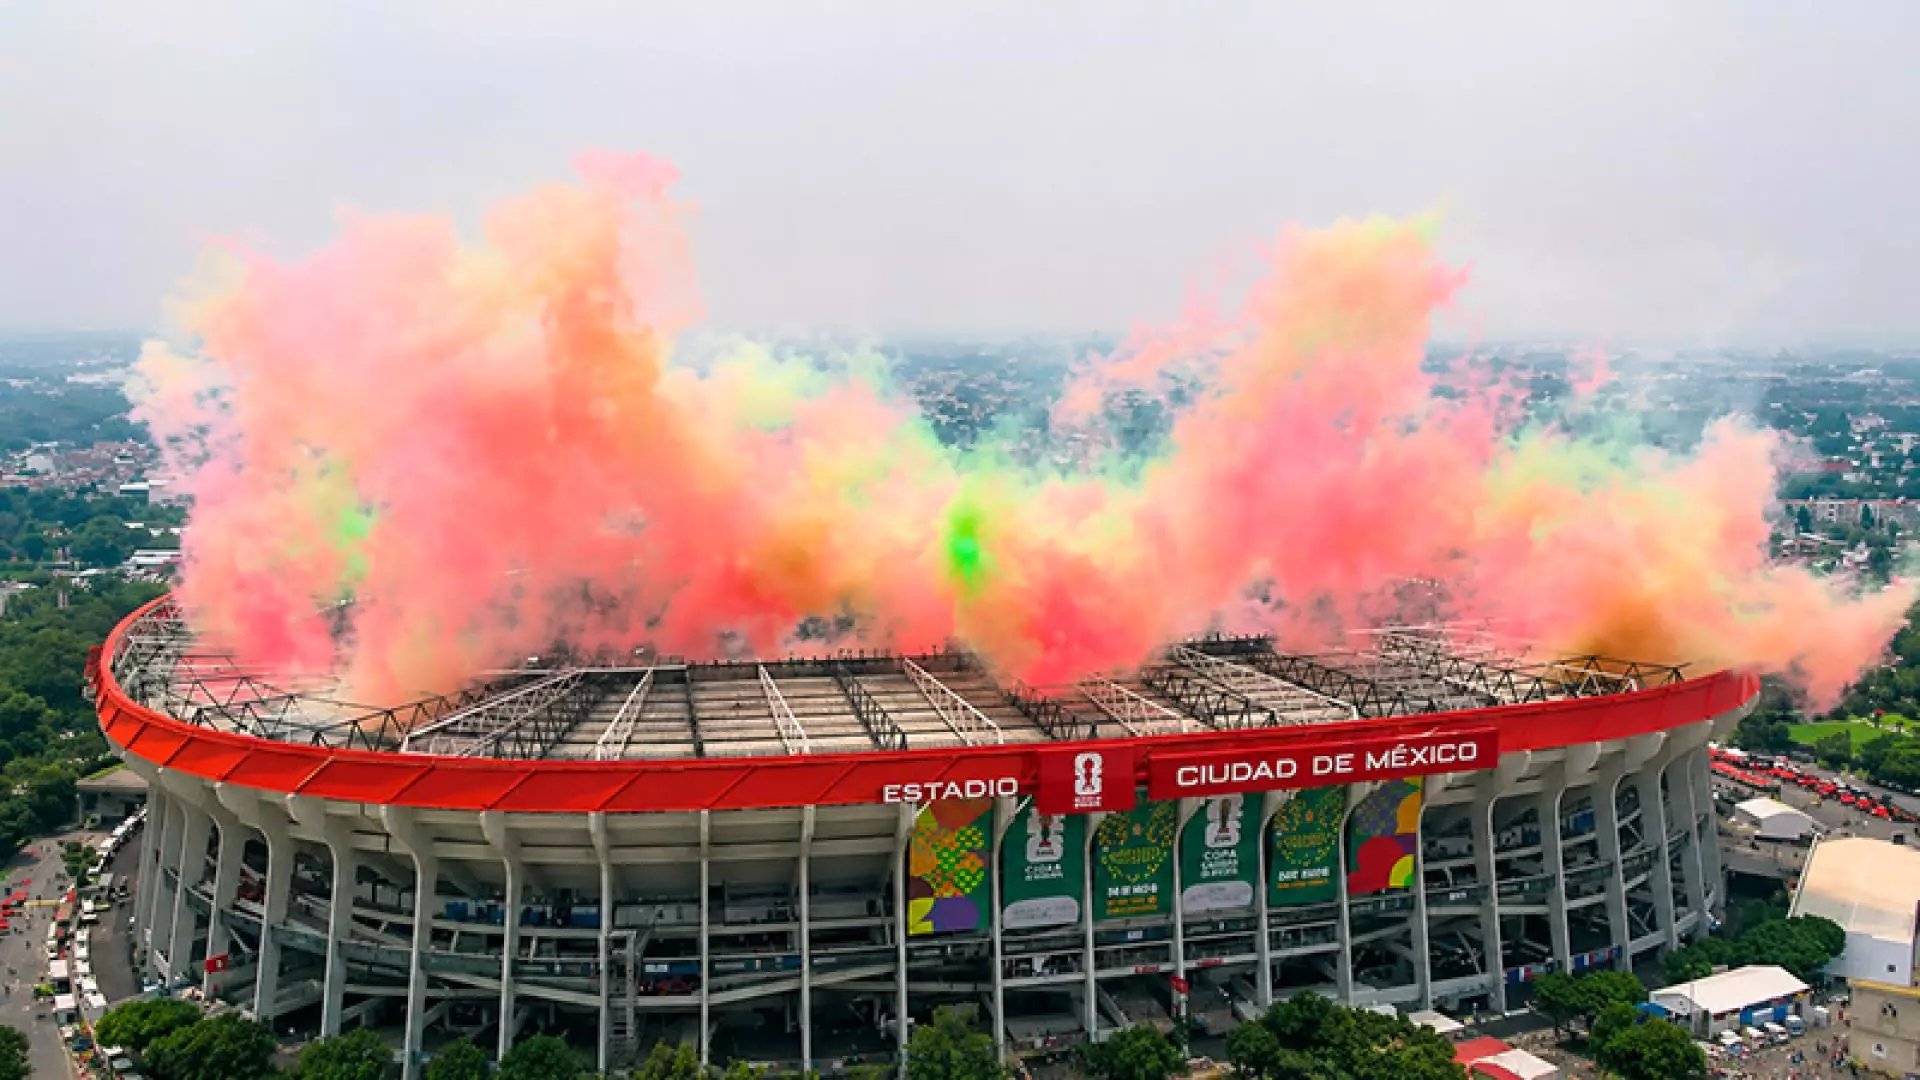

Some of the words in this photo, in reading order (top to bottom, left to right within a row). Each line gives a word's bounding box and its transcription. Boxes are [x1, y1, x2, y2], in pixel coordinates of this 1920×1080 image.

[1176, 758, 1297, 786] CIUDAD
[1312, 753, 1354, 775] DE
[1365, 742, 1477, 770] MÉXICO
[883, 777, 1018, 803] ESTADIO
